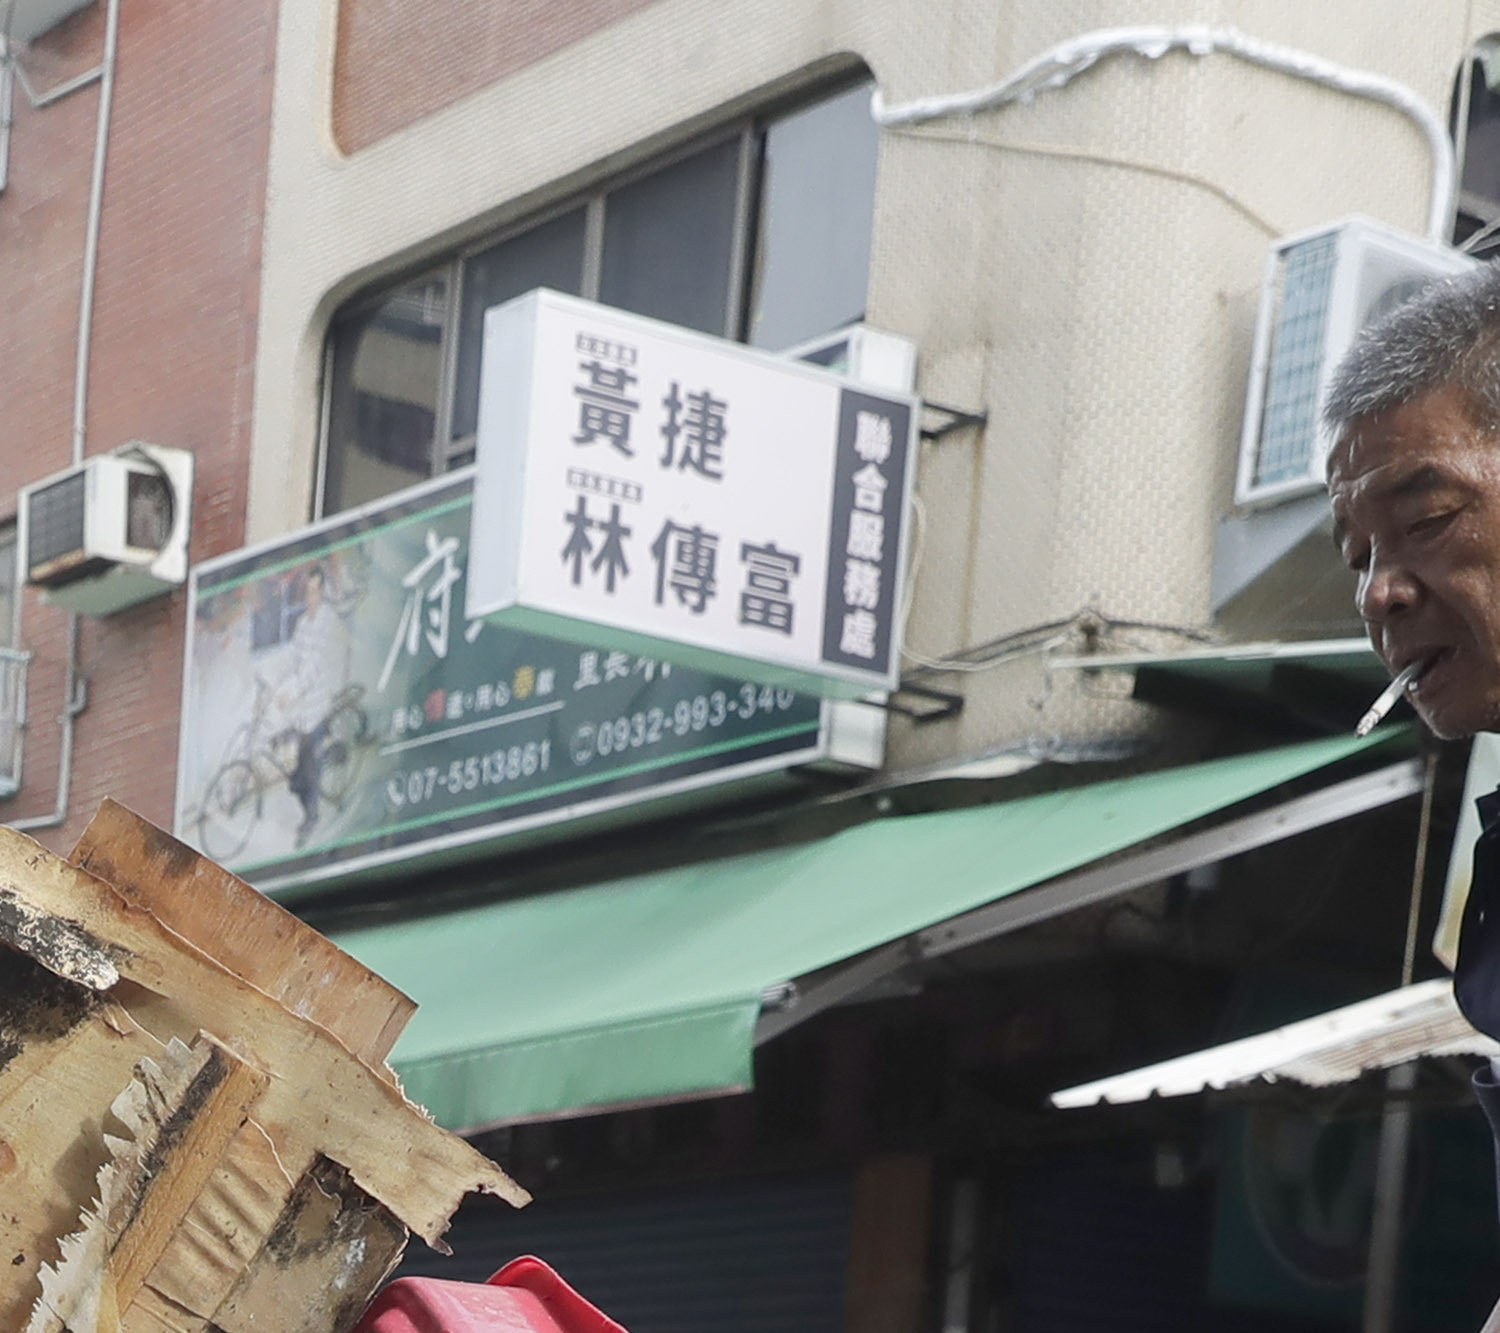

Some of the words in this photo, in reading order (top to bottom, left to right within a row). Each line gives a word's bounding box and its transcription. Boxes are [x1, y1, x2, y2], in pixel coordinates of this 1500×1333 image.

[572, 360, 728, 480] 黃捷
[560, 495, 801, 636] 林傳富
[839, 409, 893, 660] 聯合服務處
[407, 739, 551, 804] 07-5513861
